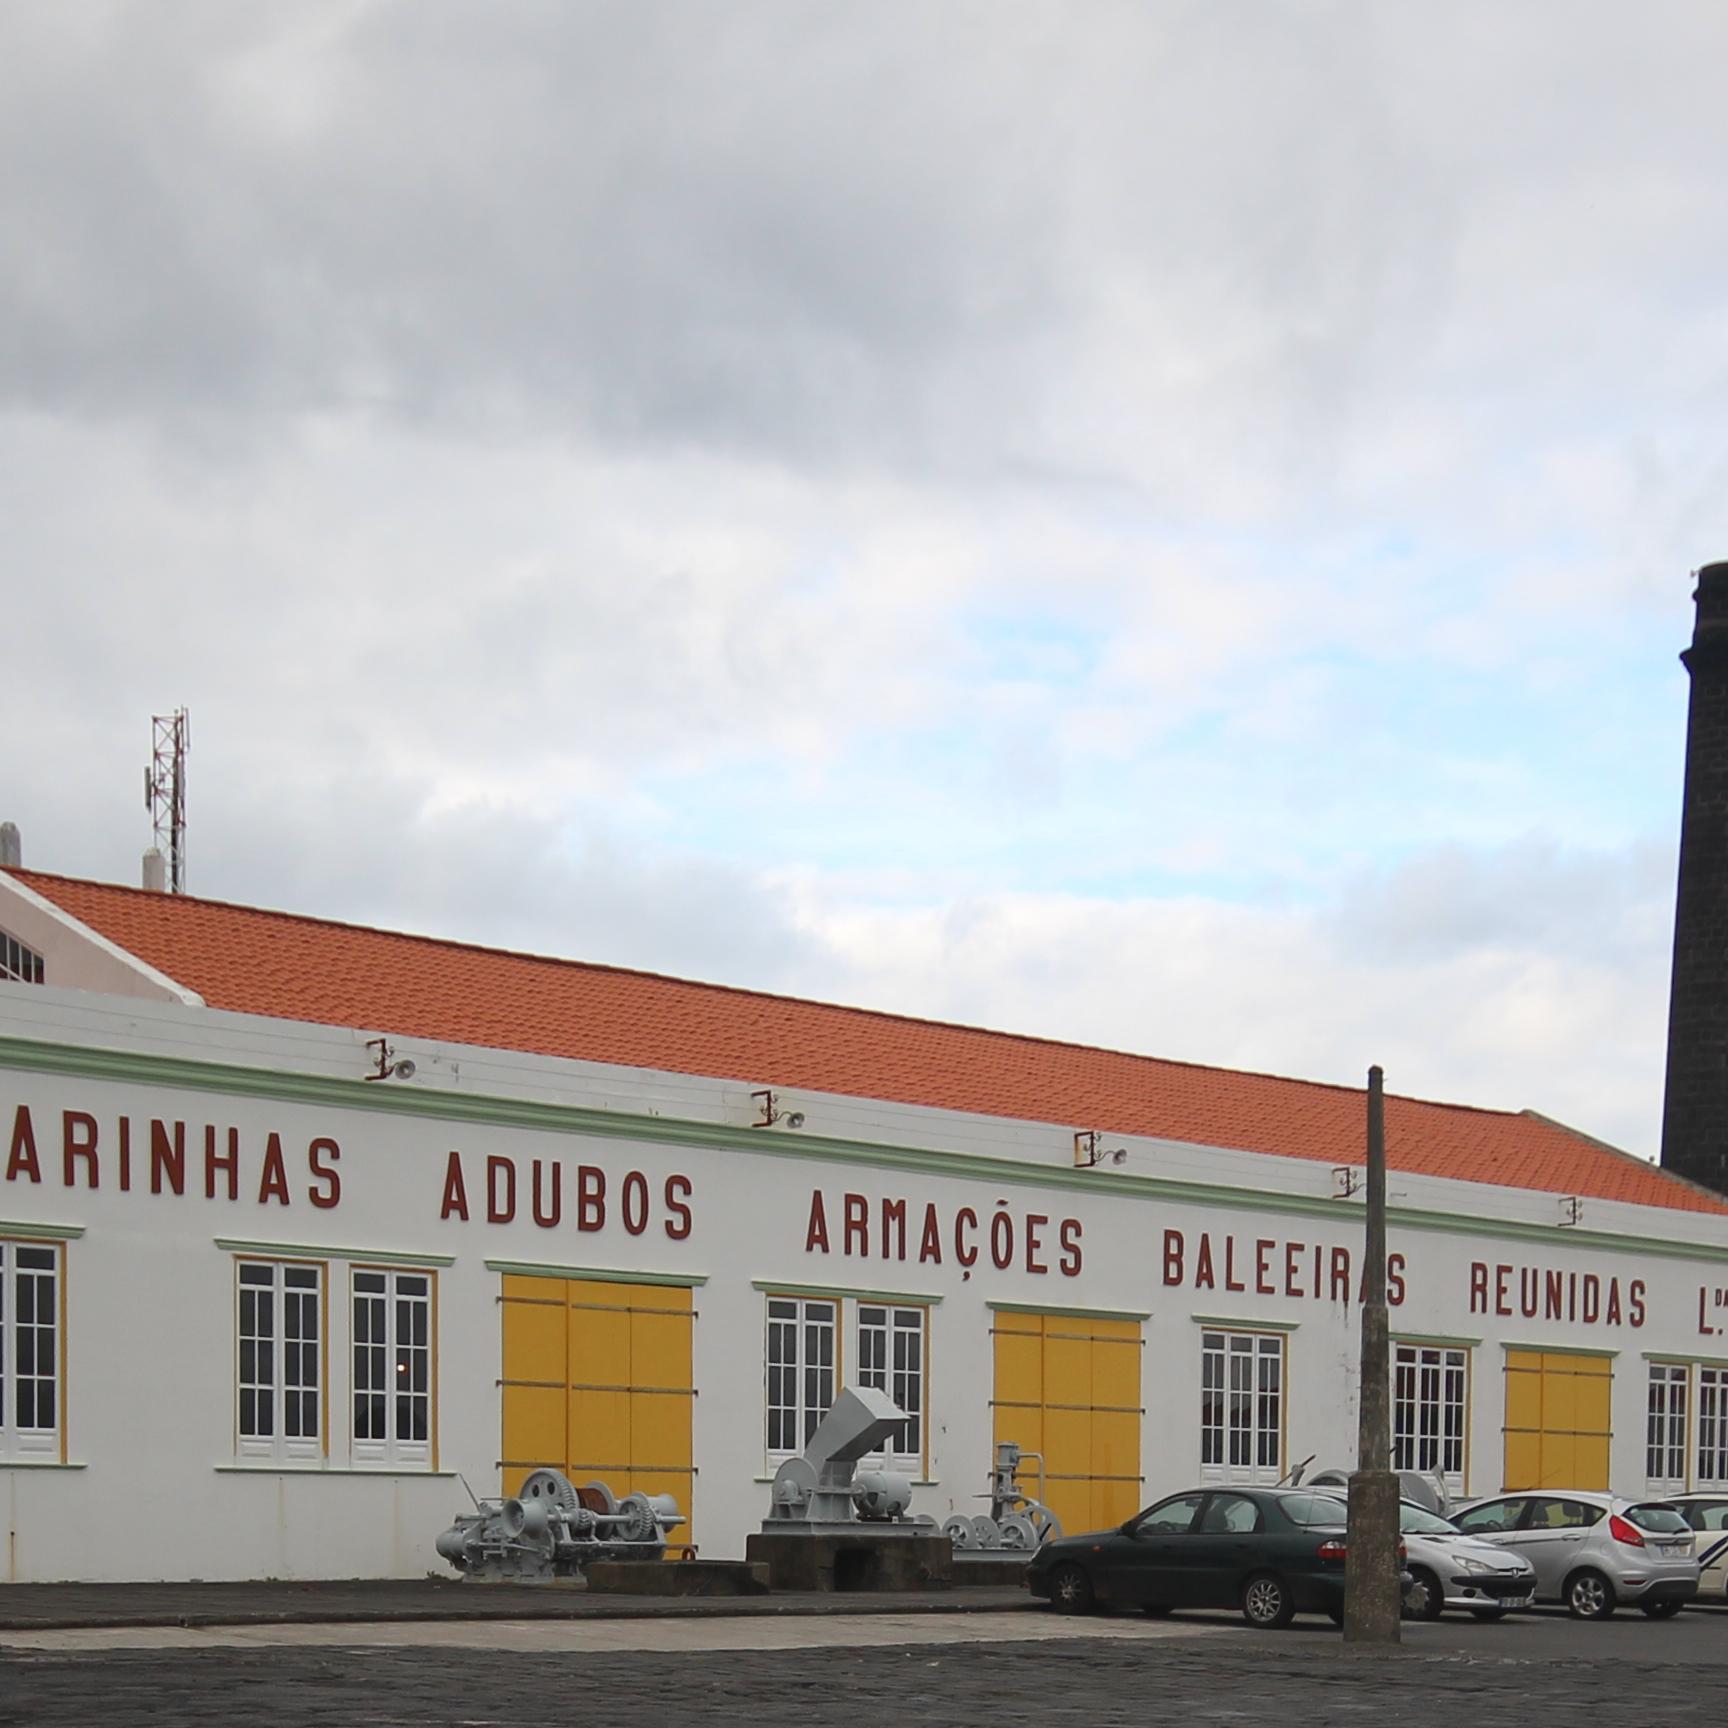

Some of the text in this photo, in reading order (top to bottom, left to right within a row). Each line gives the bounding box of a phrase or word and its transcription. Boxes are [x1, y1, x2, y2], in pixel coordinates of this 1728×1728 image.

[440, 1150, 695, 1241] ADUBOS
[805, 1190, 1084, 1282] ARMAÇÕES
[1470, 1262, 1646, 1328] REUNIDAS
